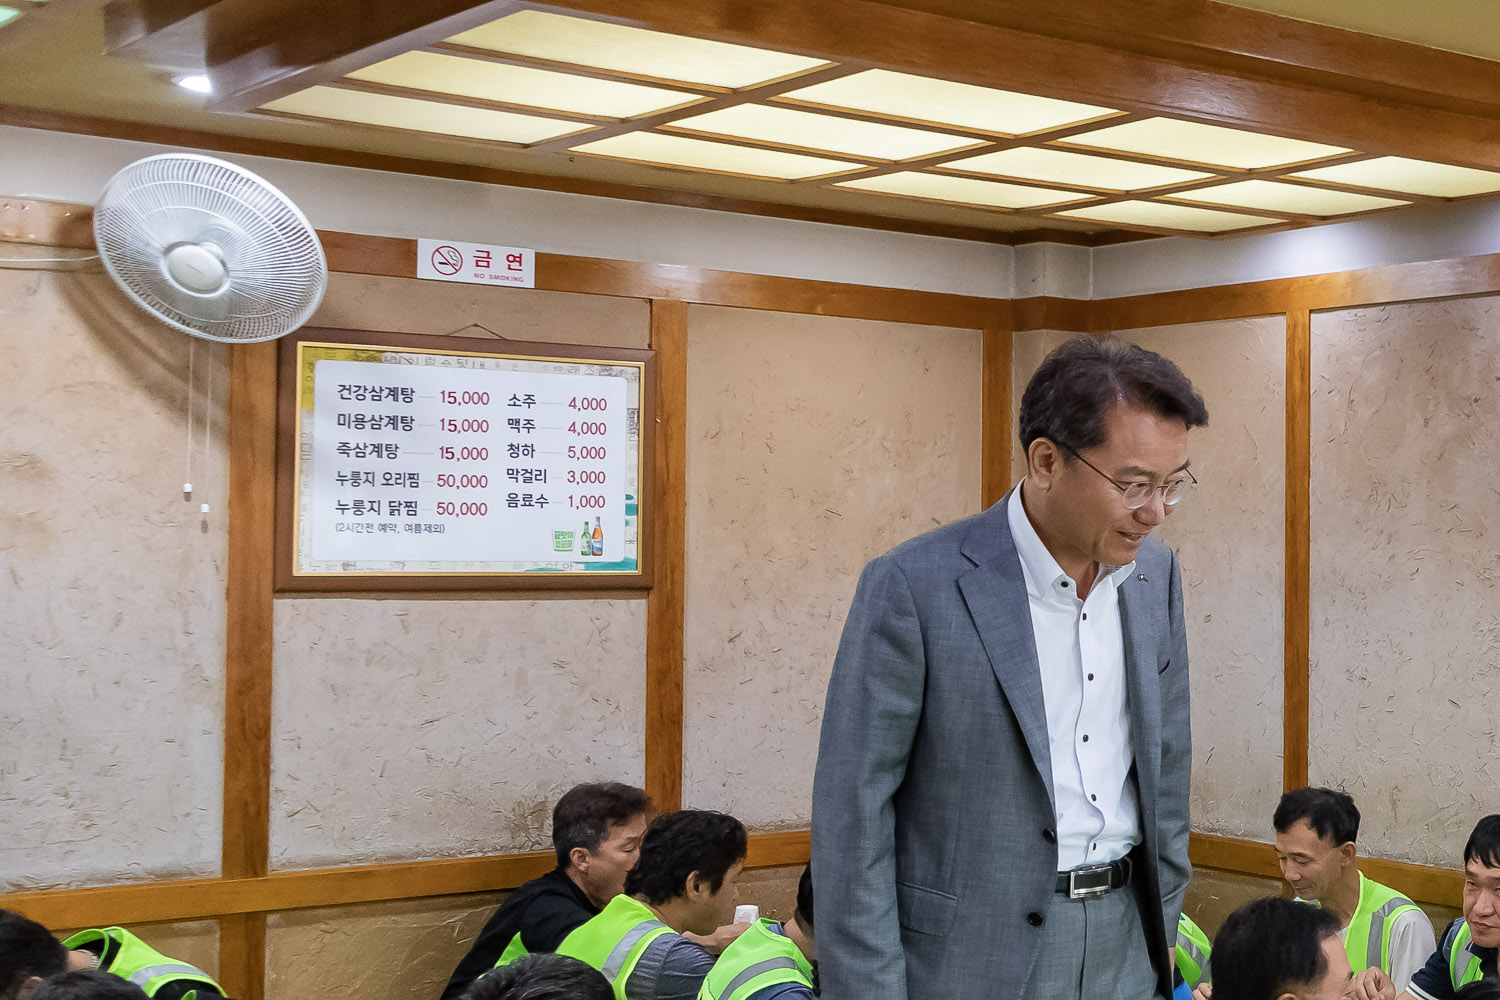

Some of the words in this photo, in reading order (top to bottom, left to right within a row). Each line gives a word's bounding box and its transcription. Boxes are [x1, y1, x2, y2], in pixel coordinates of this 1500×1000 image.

[488, 274, 524, 282] SMOKING
[337, 384, 415, 403] 건강삼계탕
[440, 390, 490, 406] 15,000
[507, 393, 537, 409] 소주
[568, 397, 607, 412] 4,000
[337, 413, 415, 432] 미용삼계탕
[440, 418, 489, 434] 15,000
[507, 418, 536, 434] 맥주
[568, 422, 607, 436] 4,000
[336, 442, 400, 460] 죽삼계탕
[439, 446, 489, 462] 15,000
[507, 443, 536, 458] 청하
[567, 446, 606, 461] 5,000
[336, 471, 375, 487] 누룽지
[381, 471, 420, 488] 오리찜
[437, 474, 488, 490] 50,000
[506, 468, 547, 484] 막걸리
[567, 470, 606, 485] 3,000
[335, 500, 381, 516] 누룽지
[388, 500, 418, 517] 닭찜
[436, 502, 488, 518] 50,000
[505, 493, 549, 509] 음료수
[568, 495, 606, 509] 1,000
[335, 523, 374, 533] (2시간전
[404, 523, 445, 534] 여름제외)
